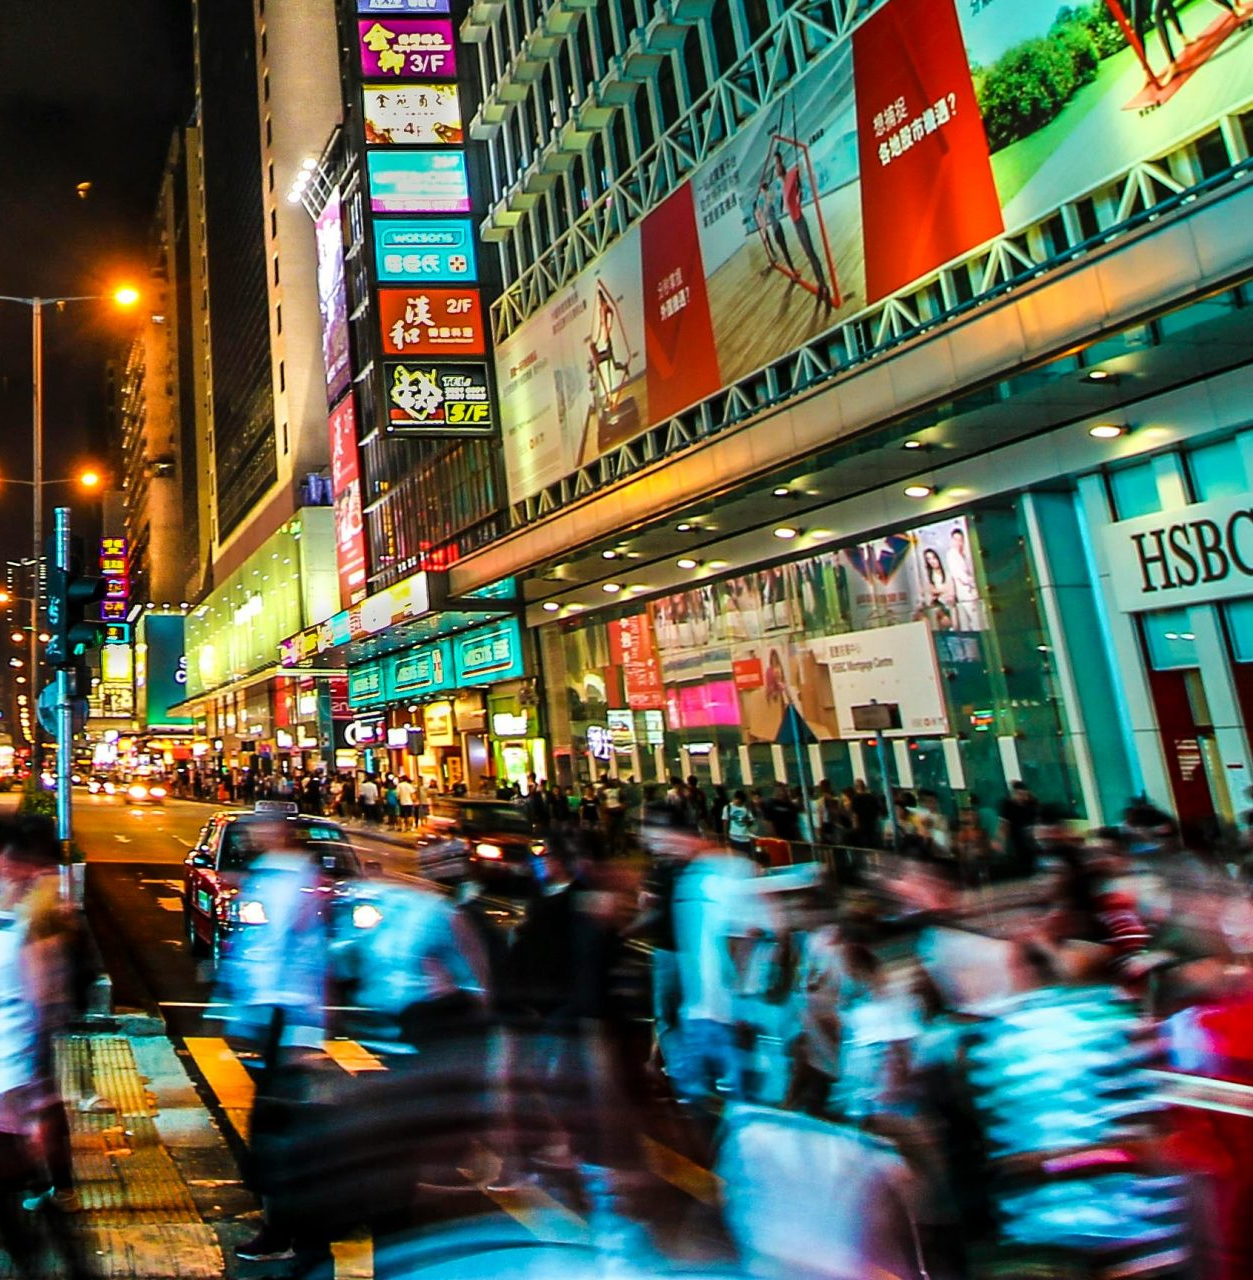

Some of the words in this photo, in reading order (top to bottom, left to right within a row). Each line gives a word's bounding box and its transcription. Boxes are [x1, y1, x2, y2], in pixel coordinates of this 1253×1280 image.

[410, 54, 445, 73] 3/F
[392, 232, 454, 243] watsons
[446, 298, 473, 313] 2/F
[1130, 507, 1253, 593] HSBC
